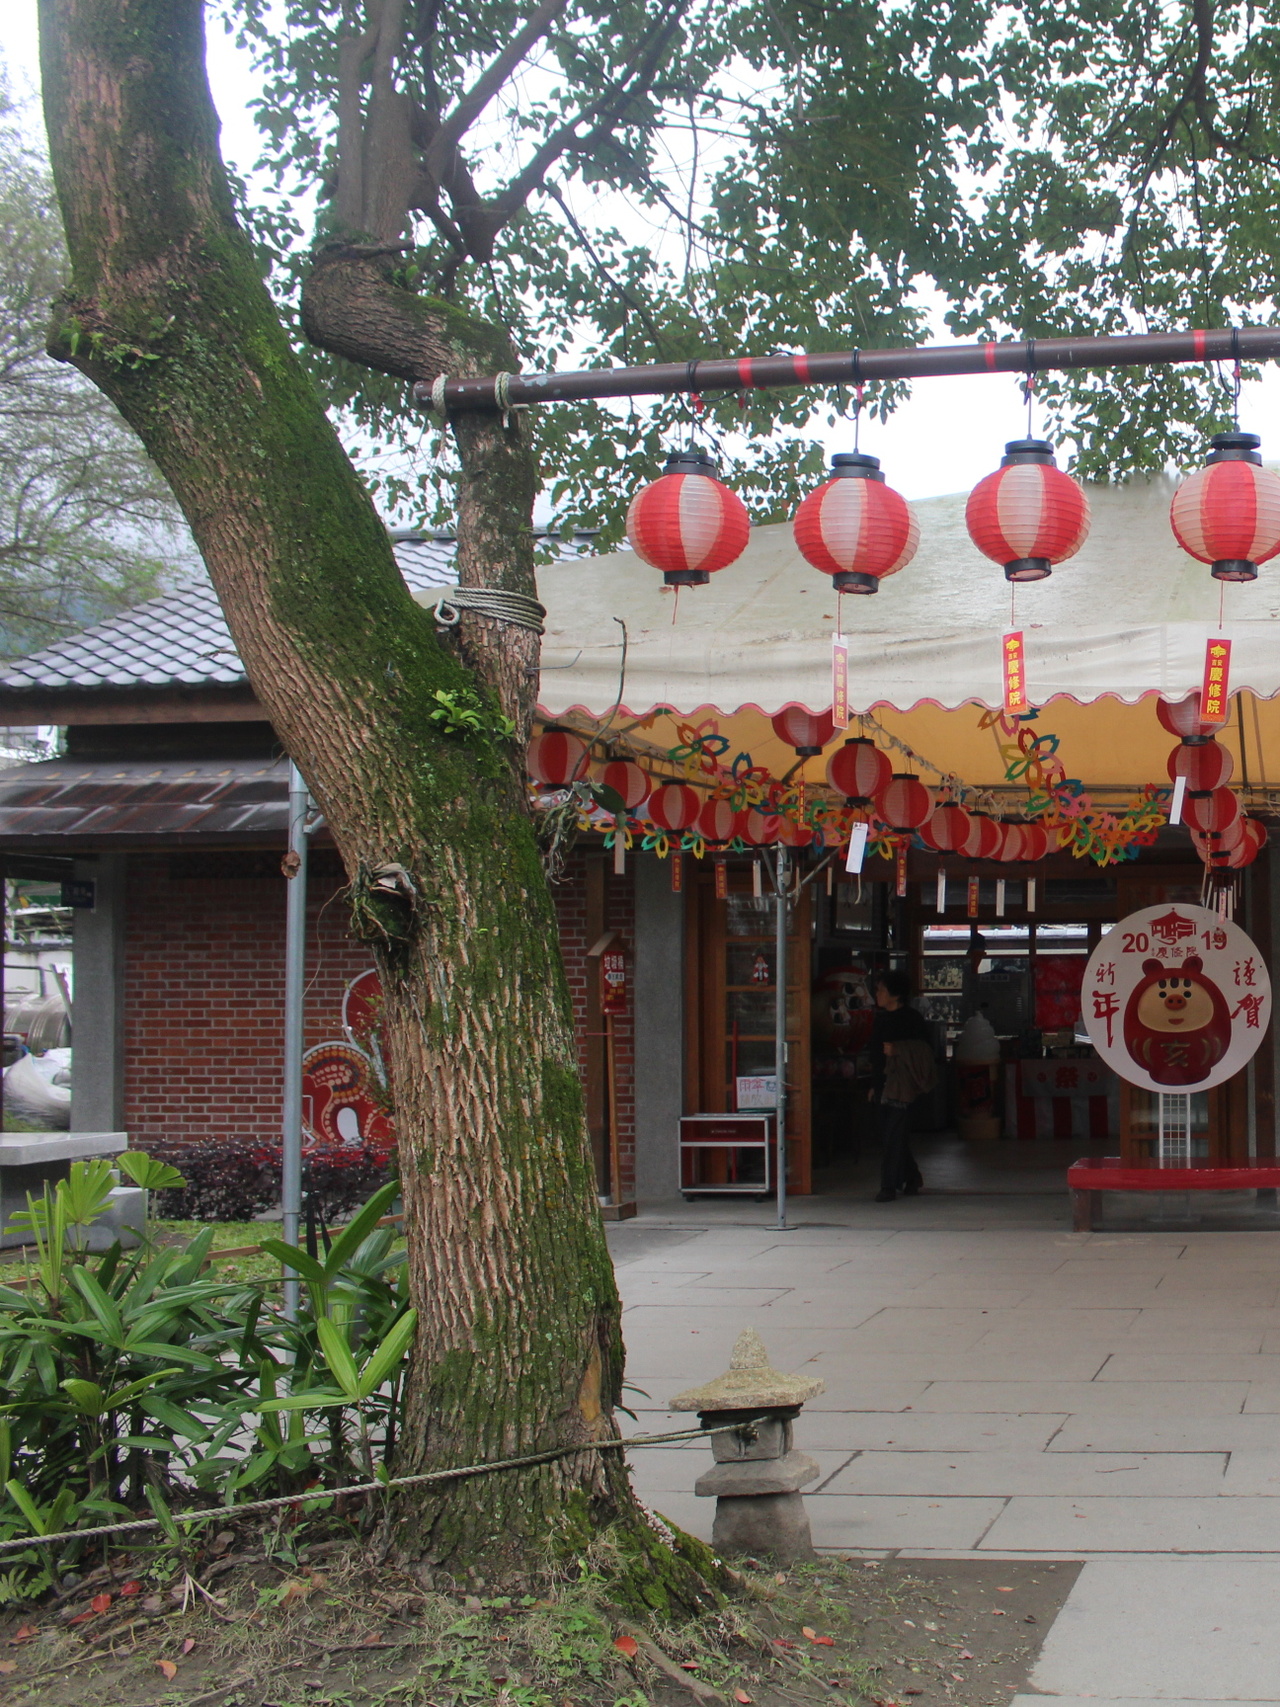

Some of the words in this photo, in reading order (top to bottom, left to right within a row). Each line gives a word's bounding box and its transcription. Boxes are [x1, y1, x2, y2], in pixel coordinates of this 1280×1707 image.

[1007, 660, 1021, 707] 慶修院
[1206, 667, 1223, 714] 慶修院
[1122, 932, 1149, 953] 20
